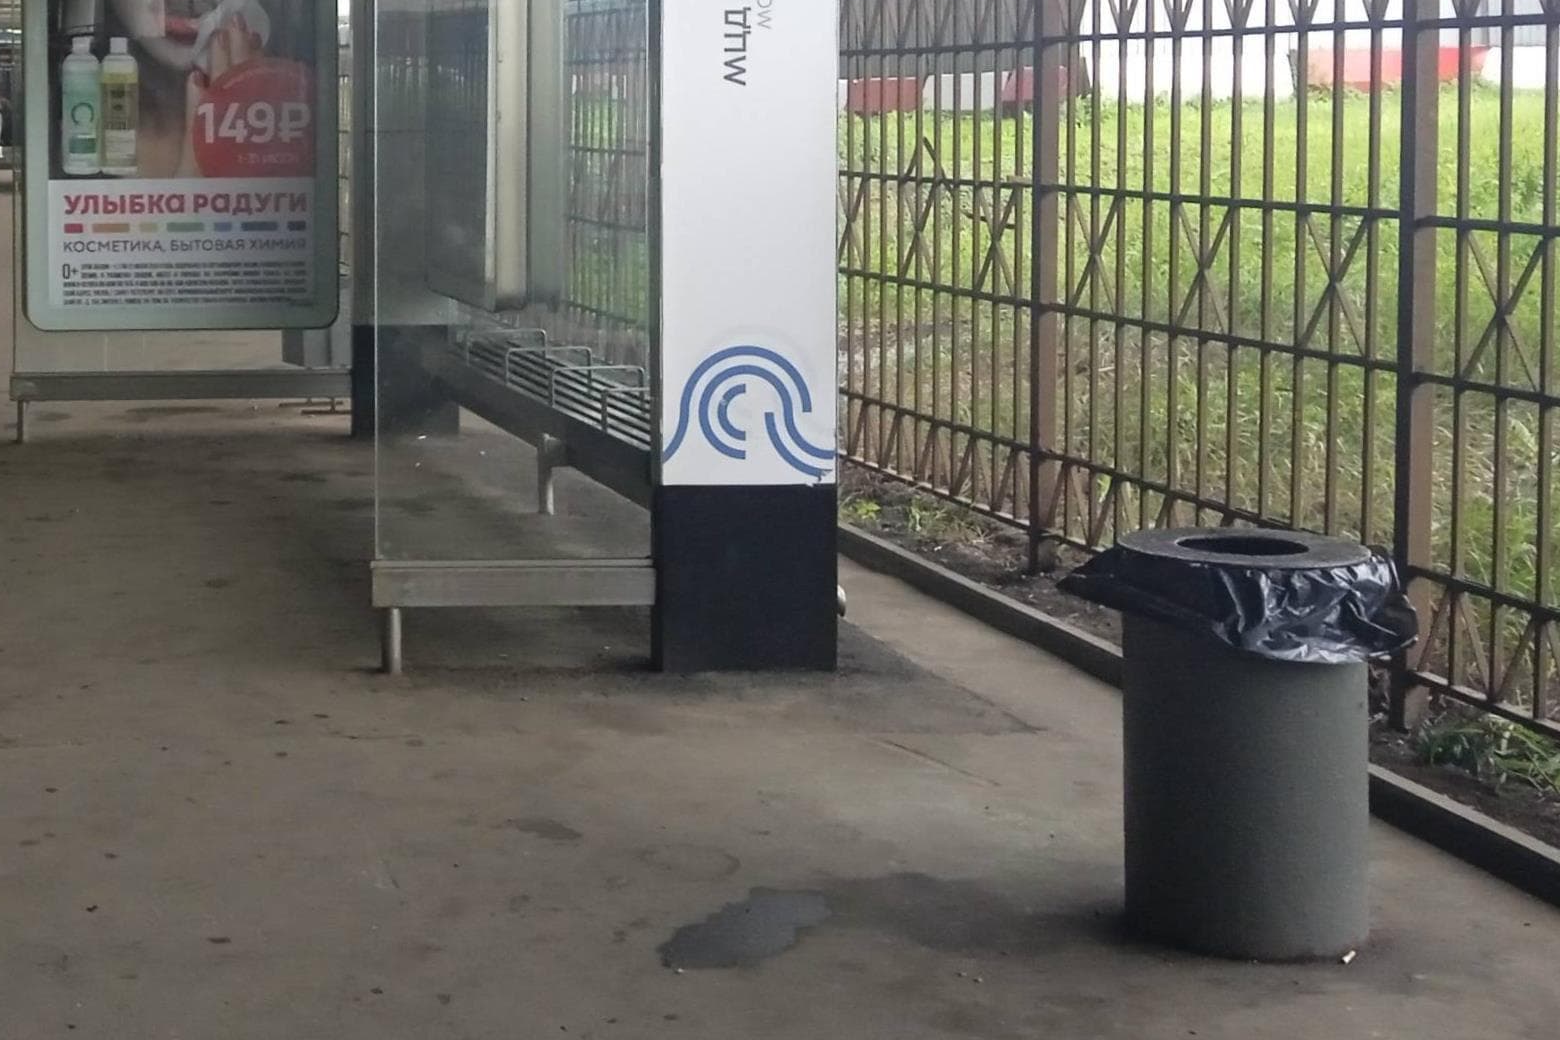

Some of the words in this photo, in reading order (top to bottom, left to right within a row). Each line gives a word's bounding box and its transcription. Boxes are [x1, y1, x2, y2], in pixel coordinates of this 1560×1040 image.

[723, 6, 752, 86] МЦД
[63, 240, 166, 253] КОСМЕТИКА,
[170, 239, 245, 252] БЫТОВАЯ
[249, 238, 307, 251] ХИМИЯ
